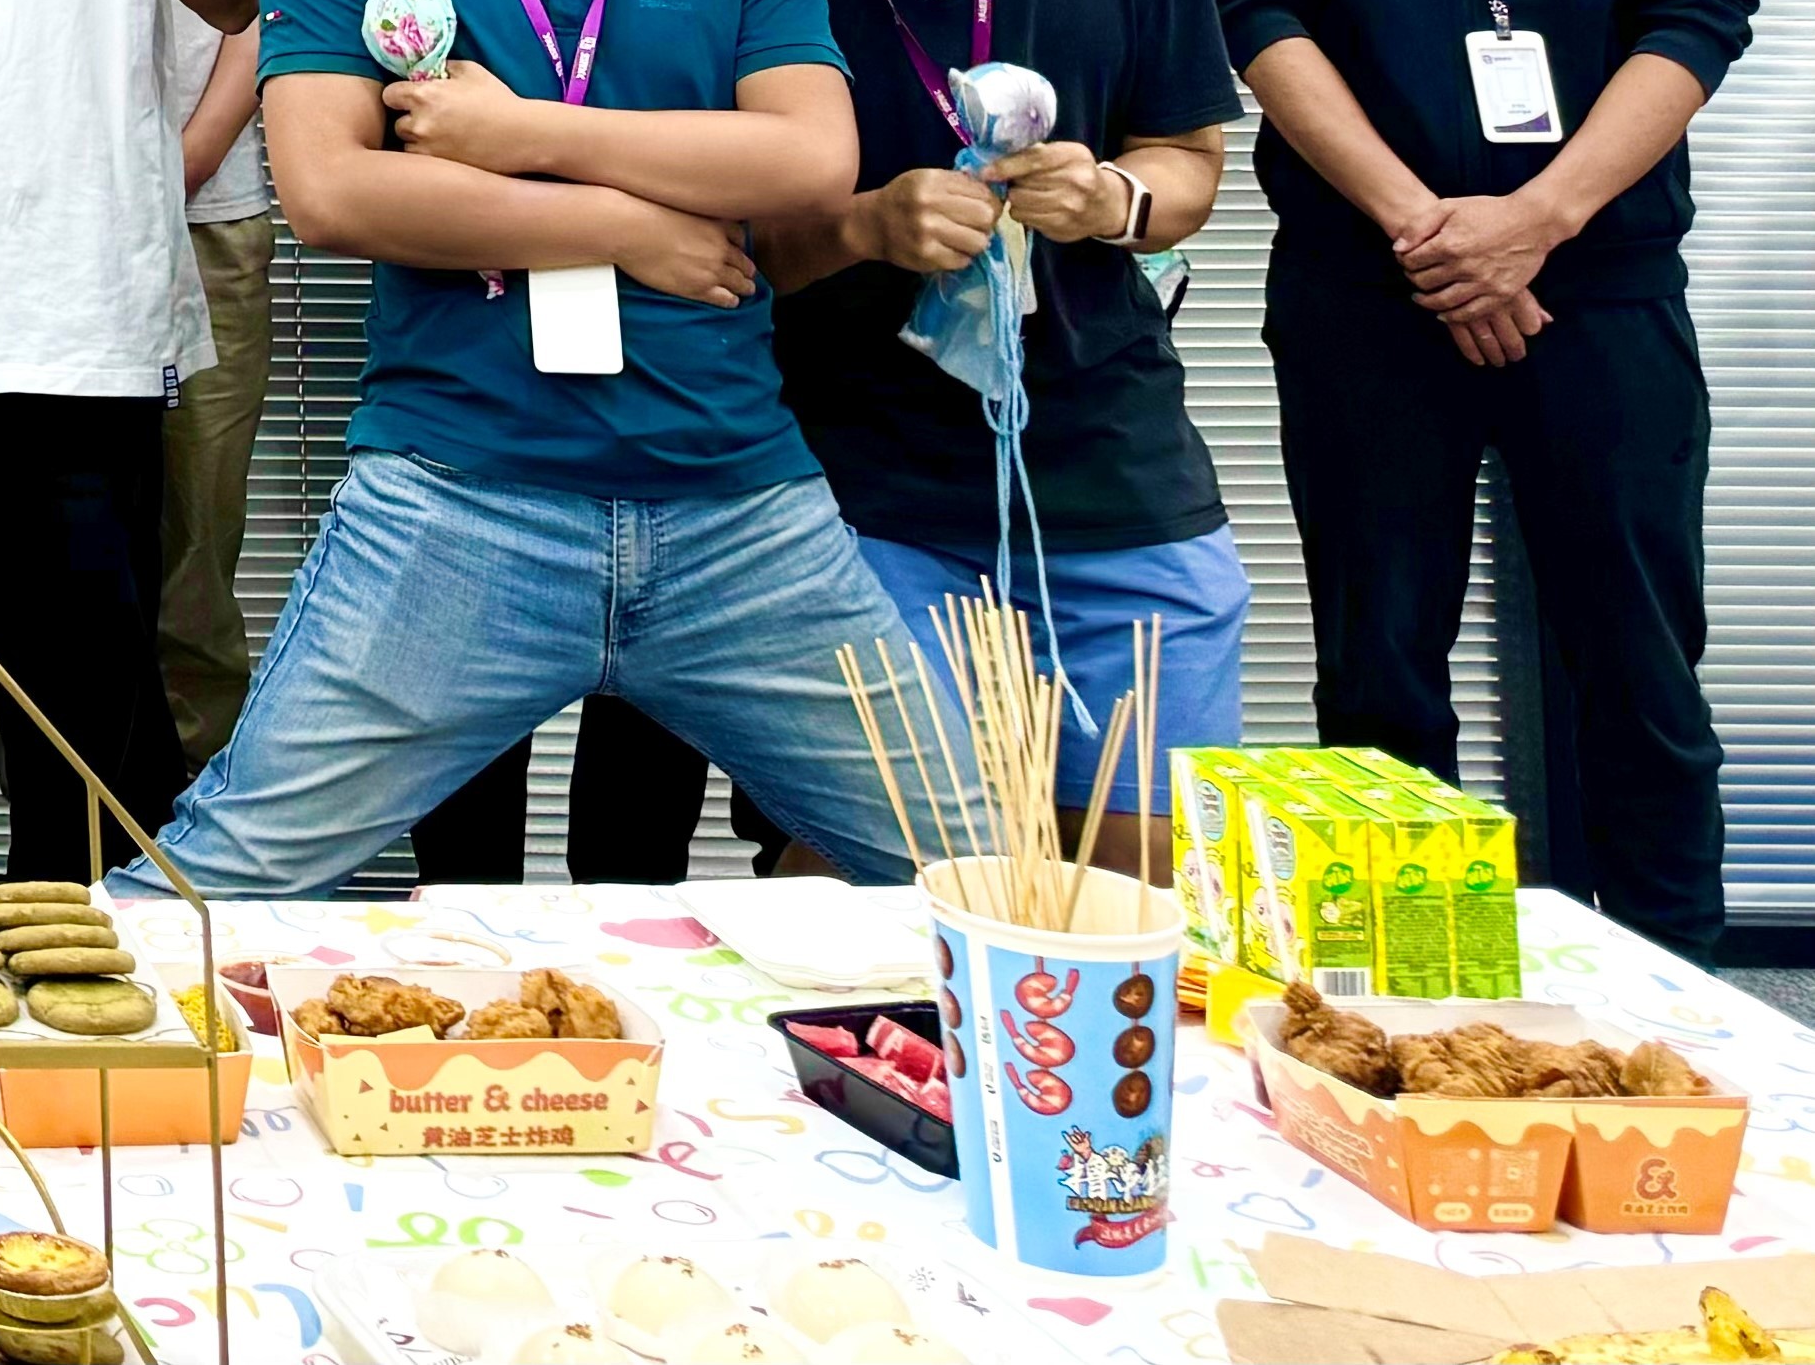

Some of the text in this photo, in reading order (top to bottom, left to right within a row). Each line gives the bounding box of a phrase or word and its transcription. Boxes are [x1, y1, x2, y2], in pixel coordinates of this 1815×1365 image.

[389, 1084, 610, 1113] butter & cheese
[422, 1125, 575, 1148] 黄油芝士炸鸡
